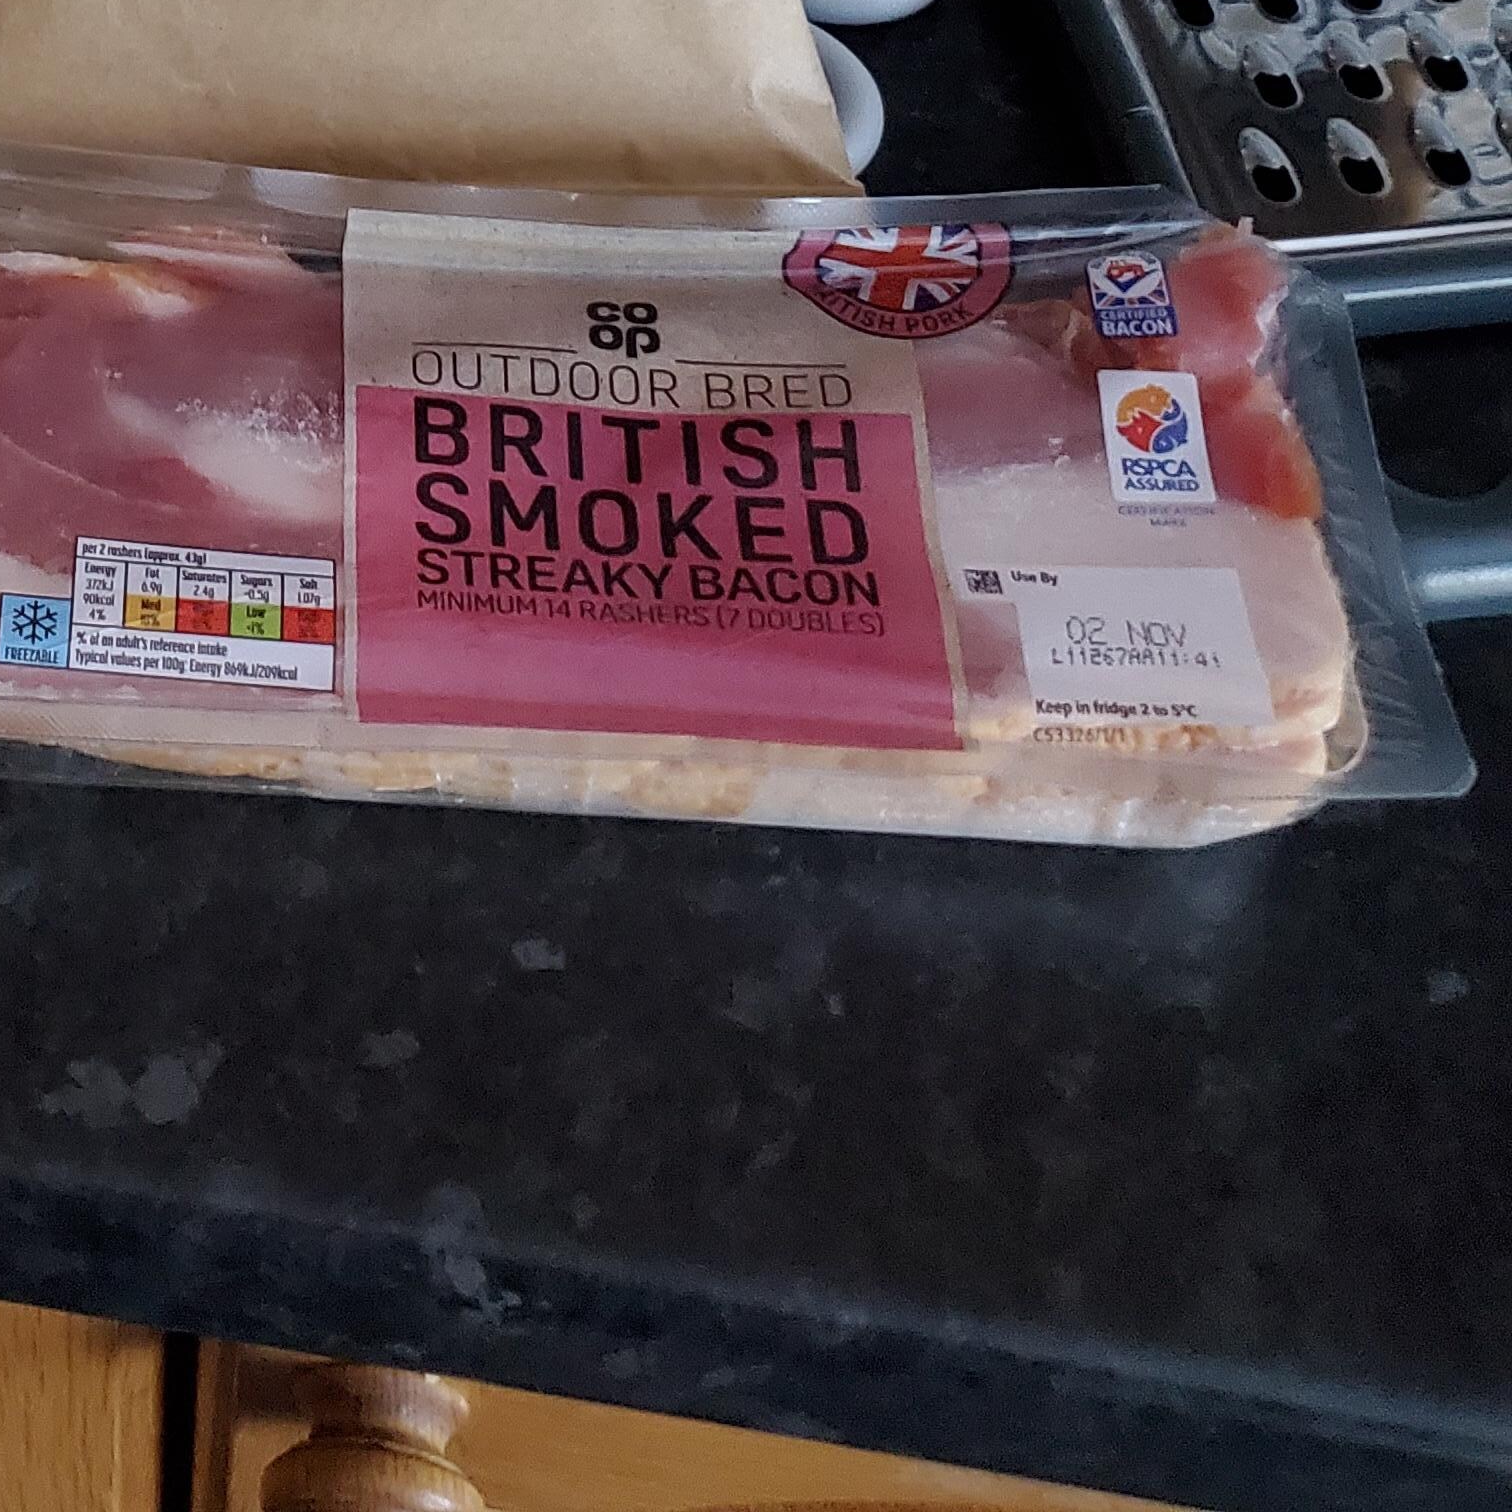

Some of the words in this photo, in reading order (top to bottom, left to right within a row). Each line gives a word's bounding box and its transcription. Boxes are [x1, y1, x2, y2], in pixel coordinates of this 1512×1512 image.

[814, 288, 896, 333] RITISH
[905, 301, 974, 334] PORK
[1099, 308, 1168, 322] CERTIFIED
[1101, 317, 1175, 337] BACON
[410, 349, 680, 409] OUTDOOR
[704, 371, 854, 410] BRED
[413, 396, 863, 493] BRITISH
[1120, 457, 1197, 479] RSPCA
[1123, 477, 1201, 493] ASSURED
[414, 471, 871, 566] SMOKED
[82, 543, 98, 556] per
[99, 544, 107, 556] 2
[107, 546, 143, 560] rashers
[416, 548, 676, 601] STREAKY
[688, 563, 882, 607] BACON
[1010, 569, 1038, 584] Use
[1040, 571, 1059, 587] By
[89, 608, 106, 621] 4%
[245, 605, 266, 619] Low
[416, 590, 539, 618] MINIMUM
[546, 597, 572, 620] 14
[579, 599, 711, 630] RASHERS
[716, 605, 743, 631] (7
[747, 608, 886, 637] DOUBLES)
[1065, 615, 1108, 647] 02
[1126, 618, 1187, 648] NOV
[4, 646, 61, 664] FREEZABLE
[1035, 699, 1072, 719] Keep
[1075, 699, 1091, 714] in
[1093, 700, 1137, 719] fridge
[1139, 703, 1150, 716] 2
[1152, 704, 1170, 717] to
